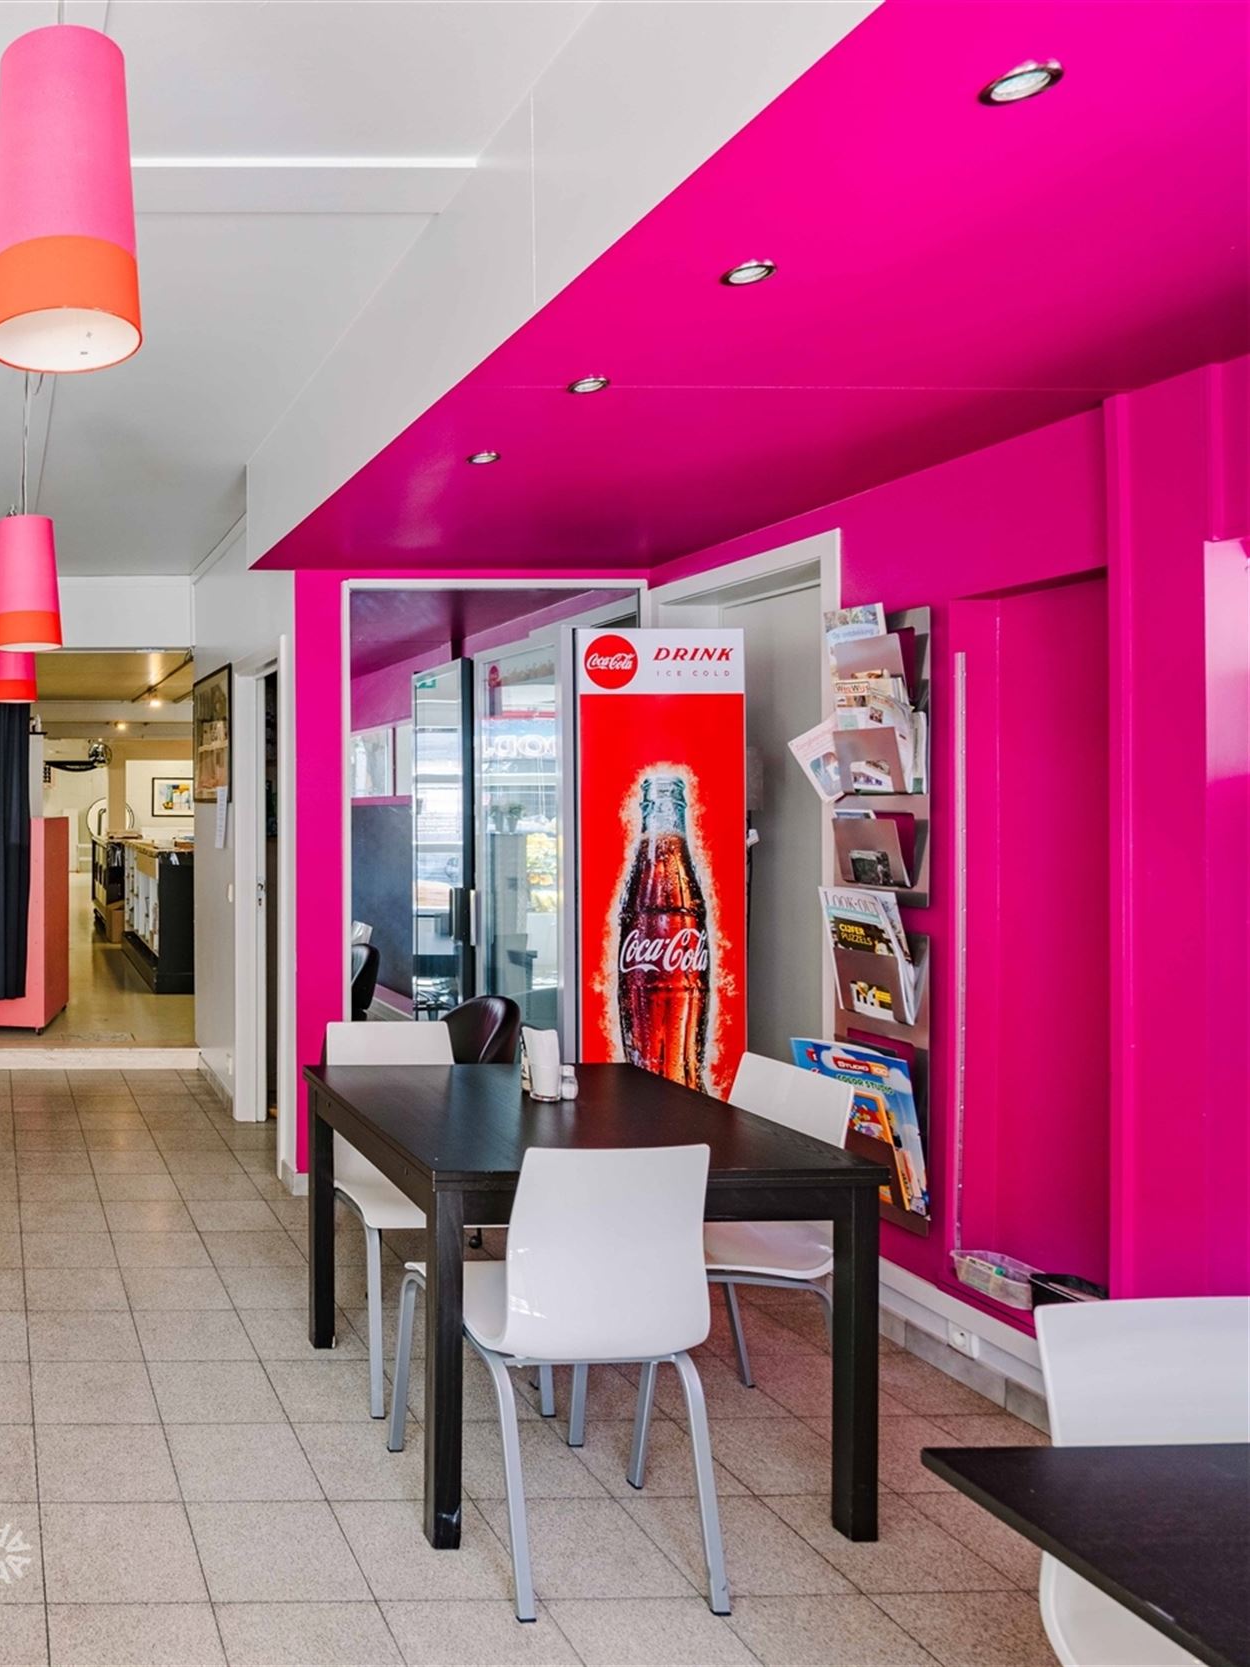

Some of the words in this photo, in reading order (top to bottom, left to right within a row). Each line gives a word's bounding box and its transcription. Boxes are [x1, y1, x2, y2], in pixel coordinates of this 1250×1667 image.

[586, 652, 636, 671] Coca-Cola
[653, 647, 733, 661] DRINK
[840, 932, 873, 946] PUZZELS
[619, 928, 709, 973] Coca-Cola
[871, 1065, 889, 1077] 100
[865, 1078, 896, 1096] STUDIO
